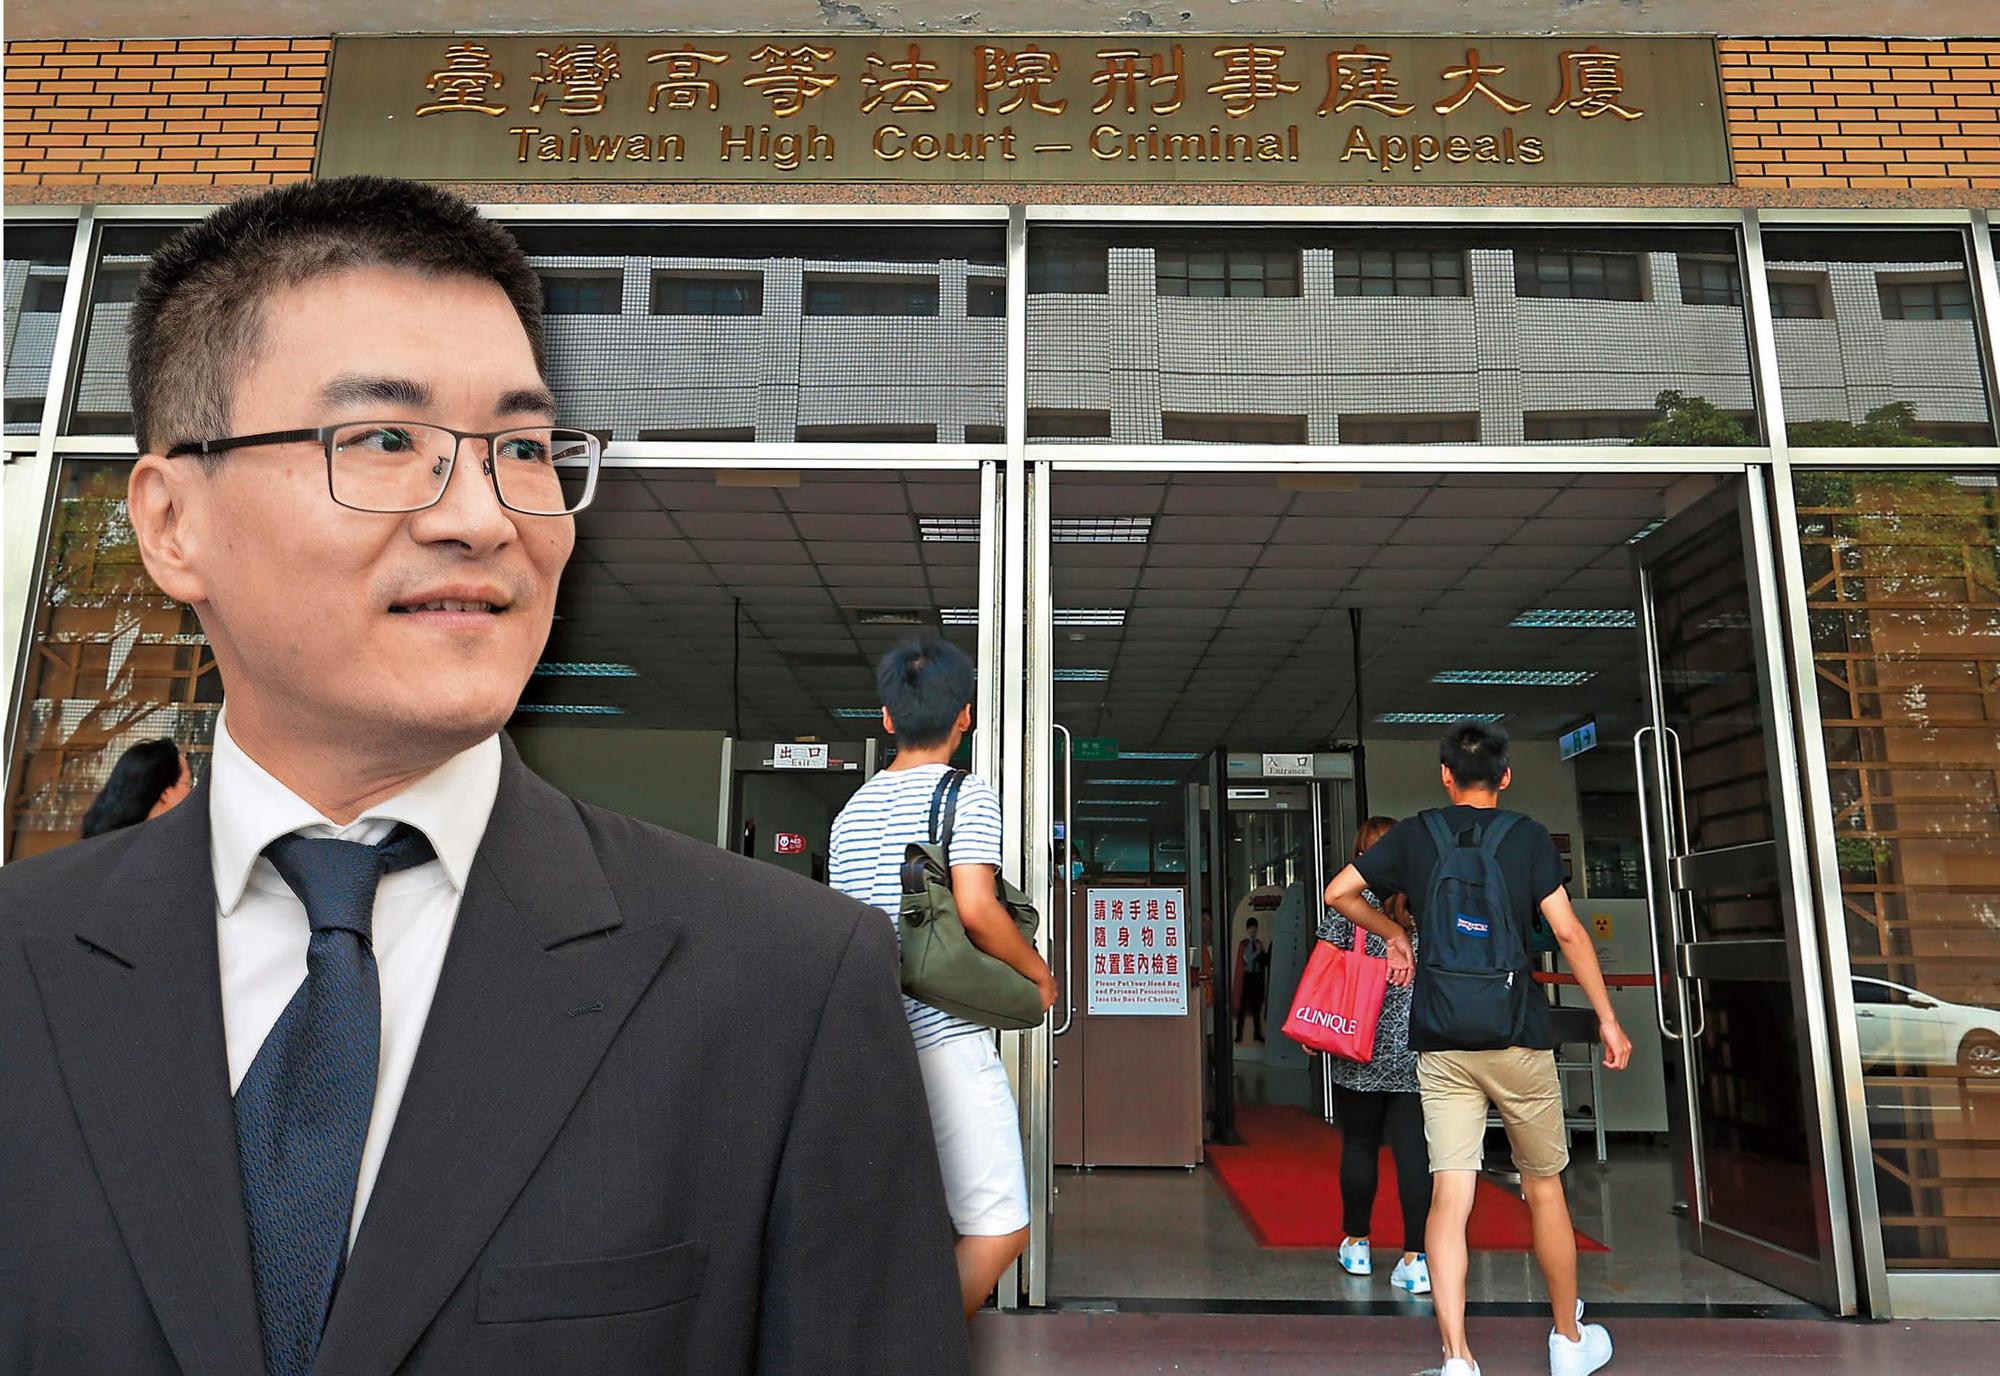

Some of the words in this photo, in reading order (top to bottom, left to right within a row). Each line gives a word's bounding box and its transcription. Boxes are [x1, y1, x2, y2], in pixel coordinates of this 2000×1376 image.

[416, 42, 1644, 121] 臺灣高等法院刑事庭大廈
[509, 126, 686, 163] Taiwan
[720, 125, 836, 171] High
[873, 125, 1017, 163] Court
[1089, 125, 1299, 163] Criminal
[1340, 125, 1545, 172] Appeals
[780, 746, 821, 759] 出口
[1269, 756, 1307, 766] 入口
[1269, 767, 1306, 775] Entrance
[1095, 900, 1176, 920] 請將手提包
[1095, 927, 1176, 947] 隨身物品
[1095, 953, 1178, 974] 放置籃內檢查
[1296, 1006, 1358, 1035] CLINIQUE
